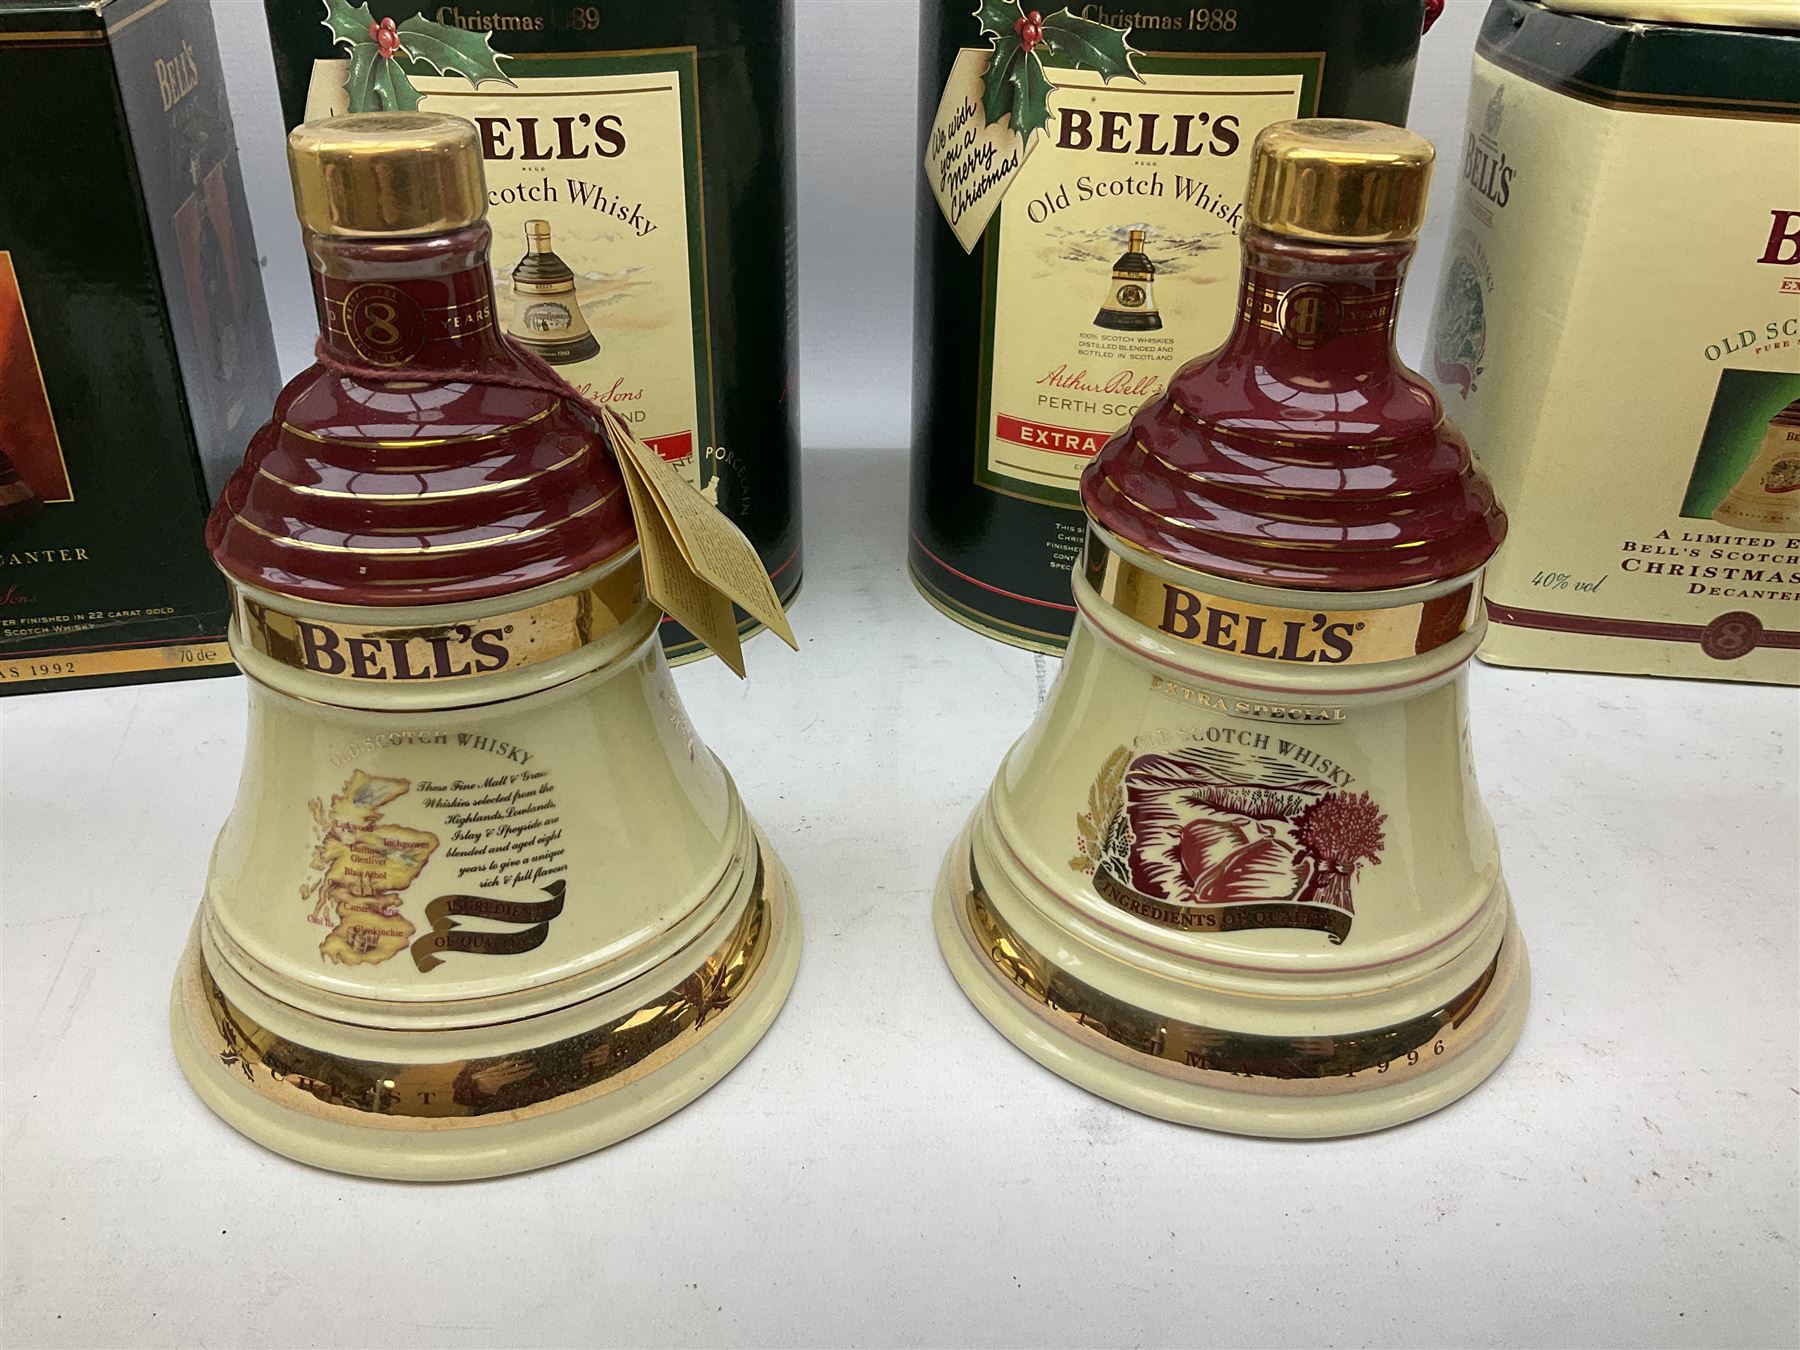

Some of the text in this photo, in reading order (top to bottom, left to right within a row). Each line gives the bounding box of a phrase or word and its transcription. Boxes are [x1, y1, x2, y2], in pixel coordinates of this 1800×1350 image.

[436, 6, 544, 31] Christmas
[1082, 5, 1238, 32] Christmas 1988
[154, 40, 198, 112] BELL'S
[948, 95, 977, 140] wish
[475, 114, 627, 160] ELL'S
[1055, 107, 1240, 157] BELL'S
[940, 127, 977, 192] you a
[1464, 131, 1515, 208] BELL'S
[951, 149, 1018, 225] Christmas
[488, 177, 659, 238] cotch Whisky
[1027, 171, 1244, 236] Old Scotch Whisk
[1757, 209, 1800, 266] B
[441, 306, 491, 329] YEARS
[1078, 340, 1118, 350] DISTILLED
[1118, 344, 1156, 353] BLENDED
[1101, 334, 1134, 343] SCOTCH
[1137, 337, 1175, 345] WHISKIES
[1704, 318, 1799, 362] OLD SC
[1755, 340, 1791, 355] PURE
[1078, 349, 1114, 358] BOTTLED
[1129, 353, 1173, 361] SCOTLAND
[1036, 364, 1101, 394] Arthur
[1104, 370, 1158, 396] Bell
[621, 410, 646, 423] ND
[1038, 394, 1140, 417] PERTH SCO
[1020, 426, 1097, 452] EXTRA
[1056, 522, 1075, 532] THIS
[1057, 533, 1084, 543] CHRIS
[1654, 528, 1671, 541] A
[1681, 532, 1776, 548] LIMITED
[1053, 553, 1075, 561] CONT
[1621, 540, 1800, 565] BELL'S SCOTCH
[1531, 570, 1608, 593] 40% vol
[1620, 557, 1800, 585] CHRISTMAS
[20, 614, 70, 625] FINISHED
[74, 613, 84, 621] IN
[88, 611, 104, 620] 22
[107, 608, 141, 619] CARAT
[145, 606, 175, 616] GOLD
[4, 627, 49, 637] SCOTCH
[31, 662, 75, 677] 1992
[1151, 675, 1347, 721] EXTRA SPECIAL
[361, 731, 448, 752] SCOTCH
[456, 732, 535, 766] WHISKY
[1178, 727, 1271, 750] SCOTCH
[1277, 738, 1356, 789] WHISKY
[416, 780, 448, 792] These
[450, 779, 476, 791] Fine
[477, 775, 507, 789] Malt
[423, 782, 554, 809] Whiskies selected from the
[445, 828, 562, 858] blended and aged eight
[451, 830, 482, 843] Islay
[497, 820, 543, 839] Speyside
[543, 816, 559, 826] are
[457, 847, 565, 877] years to give a unique
[479, 876, 499, 888] rich
[512, 869, 532, 888] full
[531, 863, 568, 884] flavour
[1102, 881, 1217, 928] INGREDIENTS
[1221, 914, 1247, 928] OF
